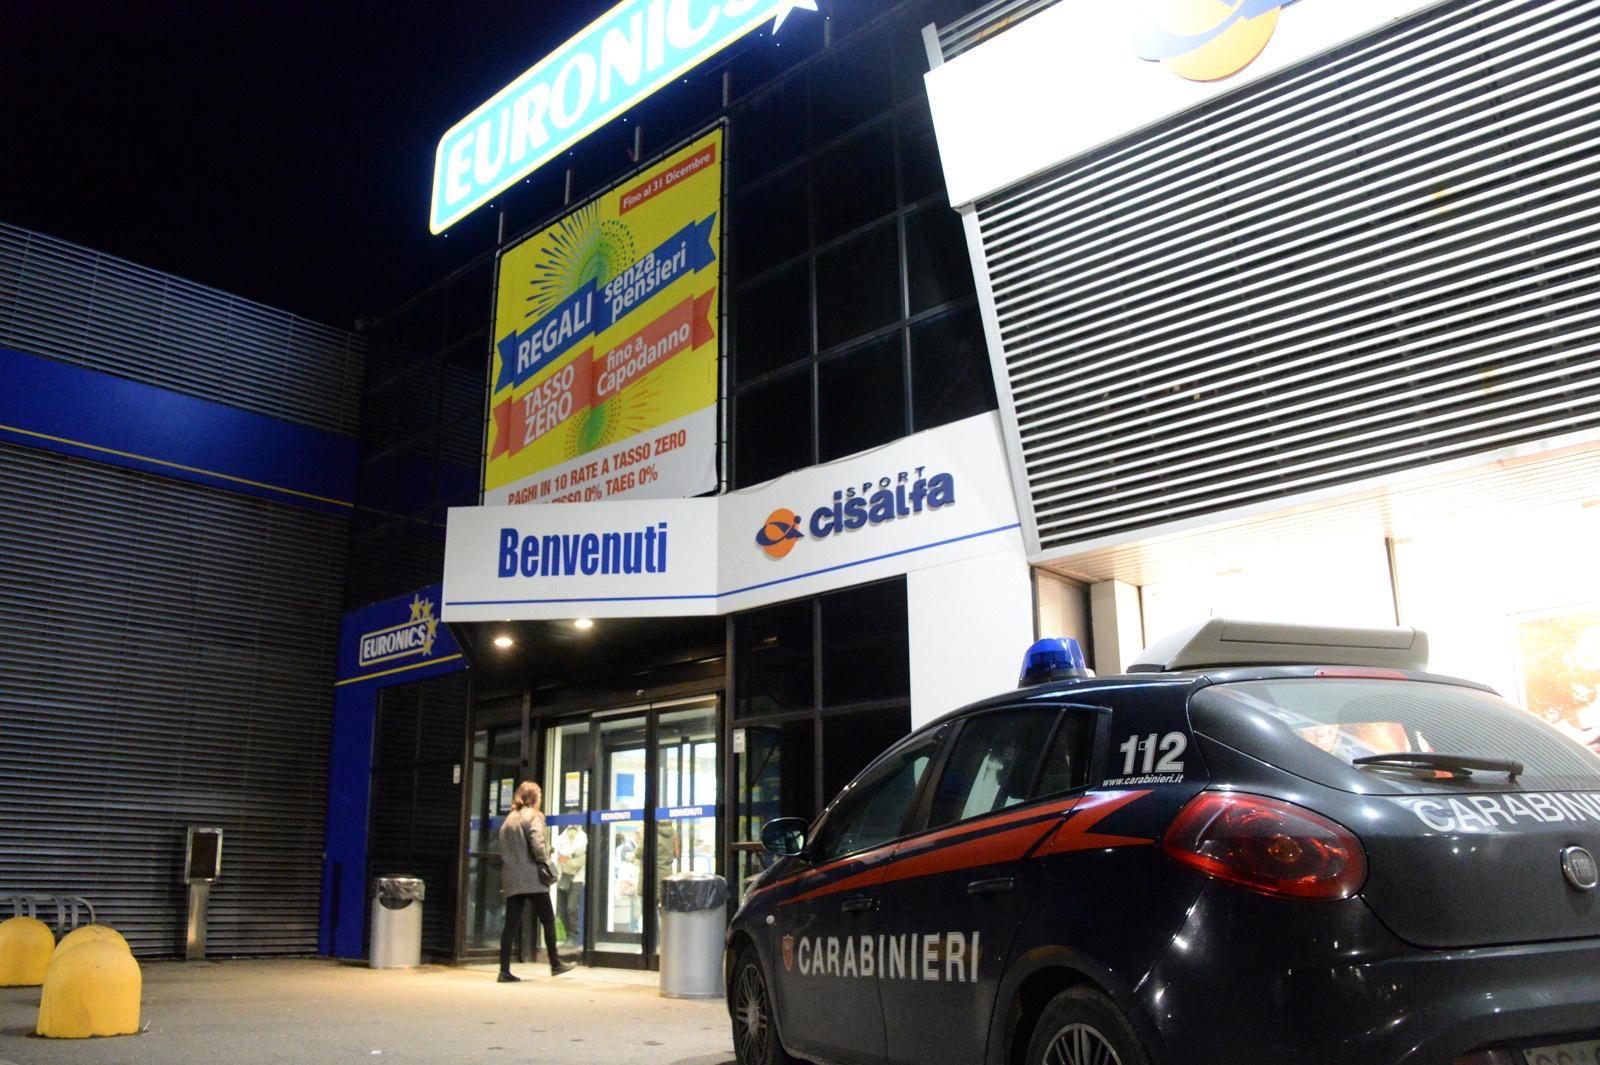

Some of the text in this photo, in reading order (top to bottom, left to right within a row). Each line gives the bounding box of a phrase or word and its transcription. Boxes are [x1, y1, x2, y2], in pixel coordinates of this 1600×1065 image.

[444, 0, 758, 205] EURONIC
[623, 153, 711, 209] Fino al 31 Dicembre
[604, 252, 656, 303] senza
[611, 241, 687, 322] pensieri
[517, 292, 593, 375] REGALI
[597, 322, 690, 397] Capodanno
[607, 336, 645, 372] fino a
[523, 364, 575, 418] TASSO
[523, 391, 572, 447] ZERO
[508, 429, 687, 505] PAGHI IN 10 RATE A TASSO ZERO
[584, 483, 603, 503] 0%
[606, 472, 635, 496] TAEG
[638, 463, 658, 485] 0%
[845, 465, 925, 498] SPORT
[809, 472, 955, 539] cisalfa
[498, 522, 667, 578] Benvenuti
[363, 624, 426, 659] EURONICS
[1119, 731, 1188, 775] 112
[1102, 774, 1184, 787] www.carabinieri.it
[1413, 793, 1600, 832] CARABINI
[798, 931, 980, 983] CARABINIERI
